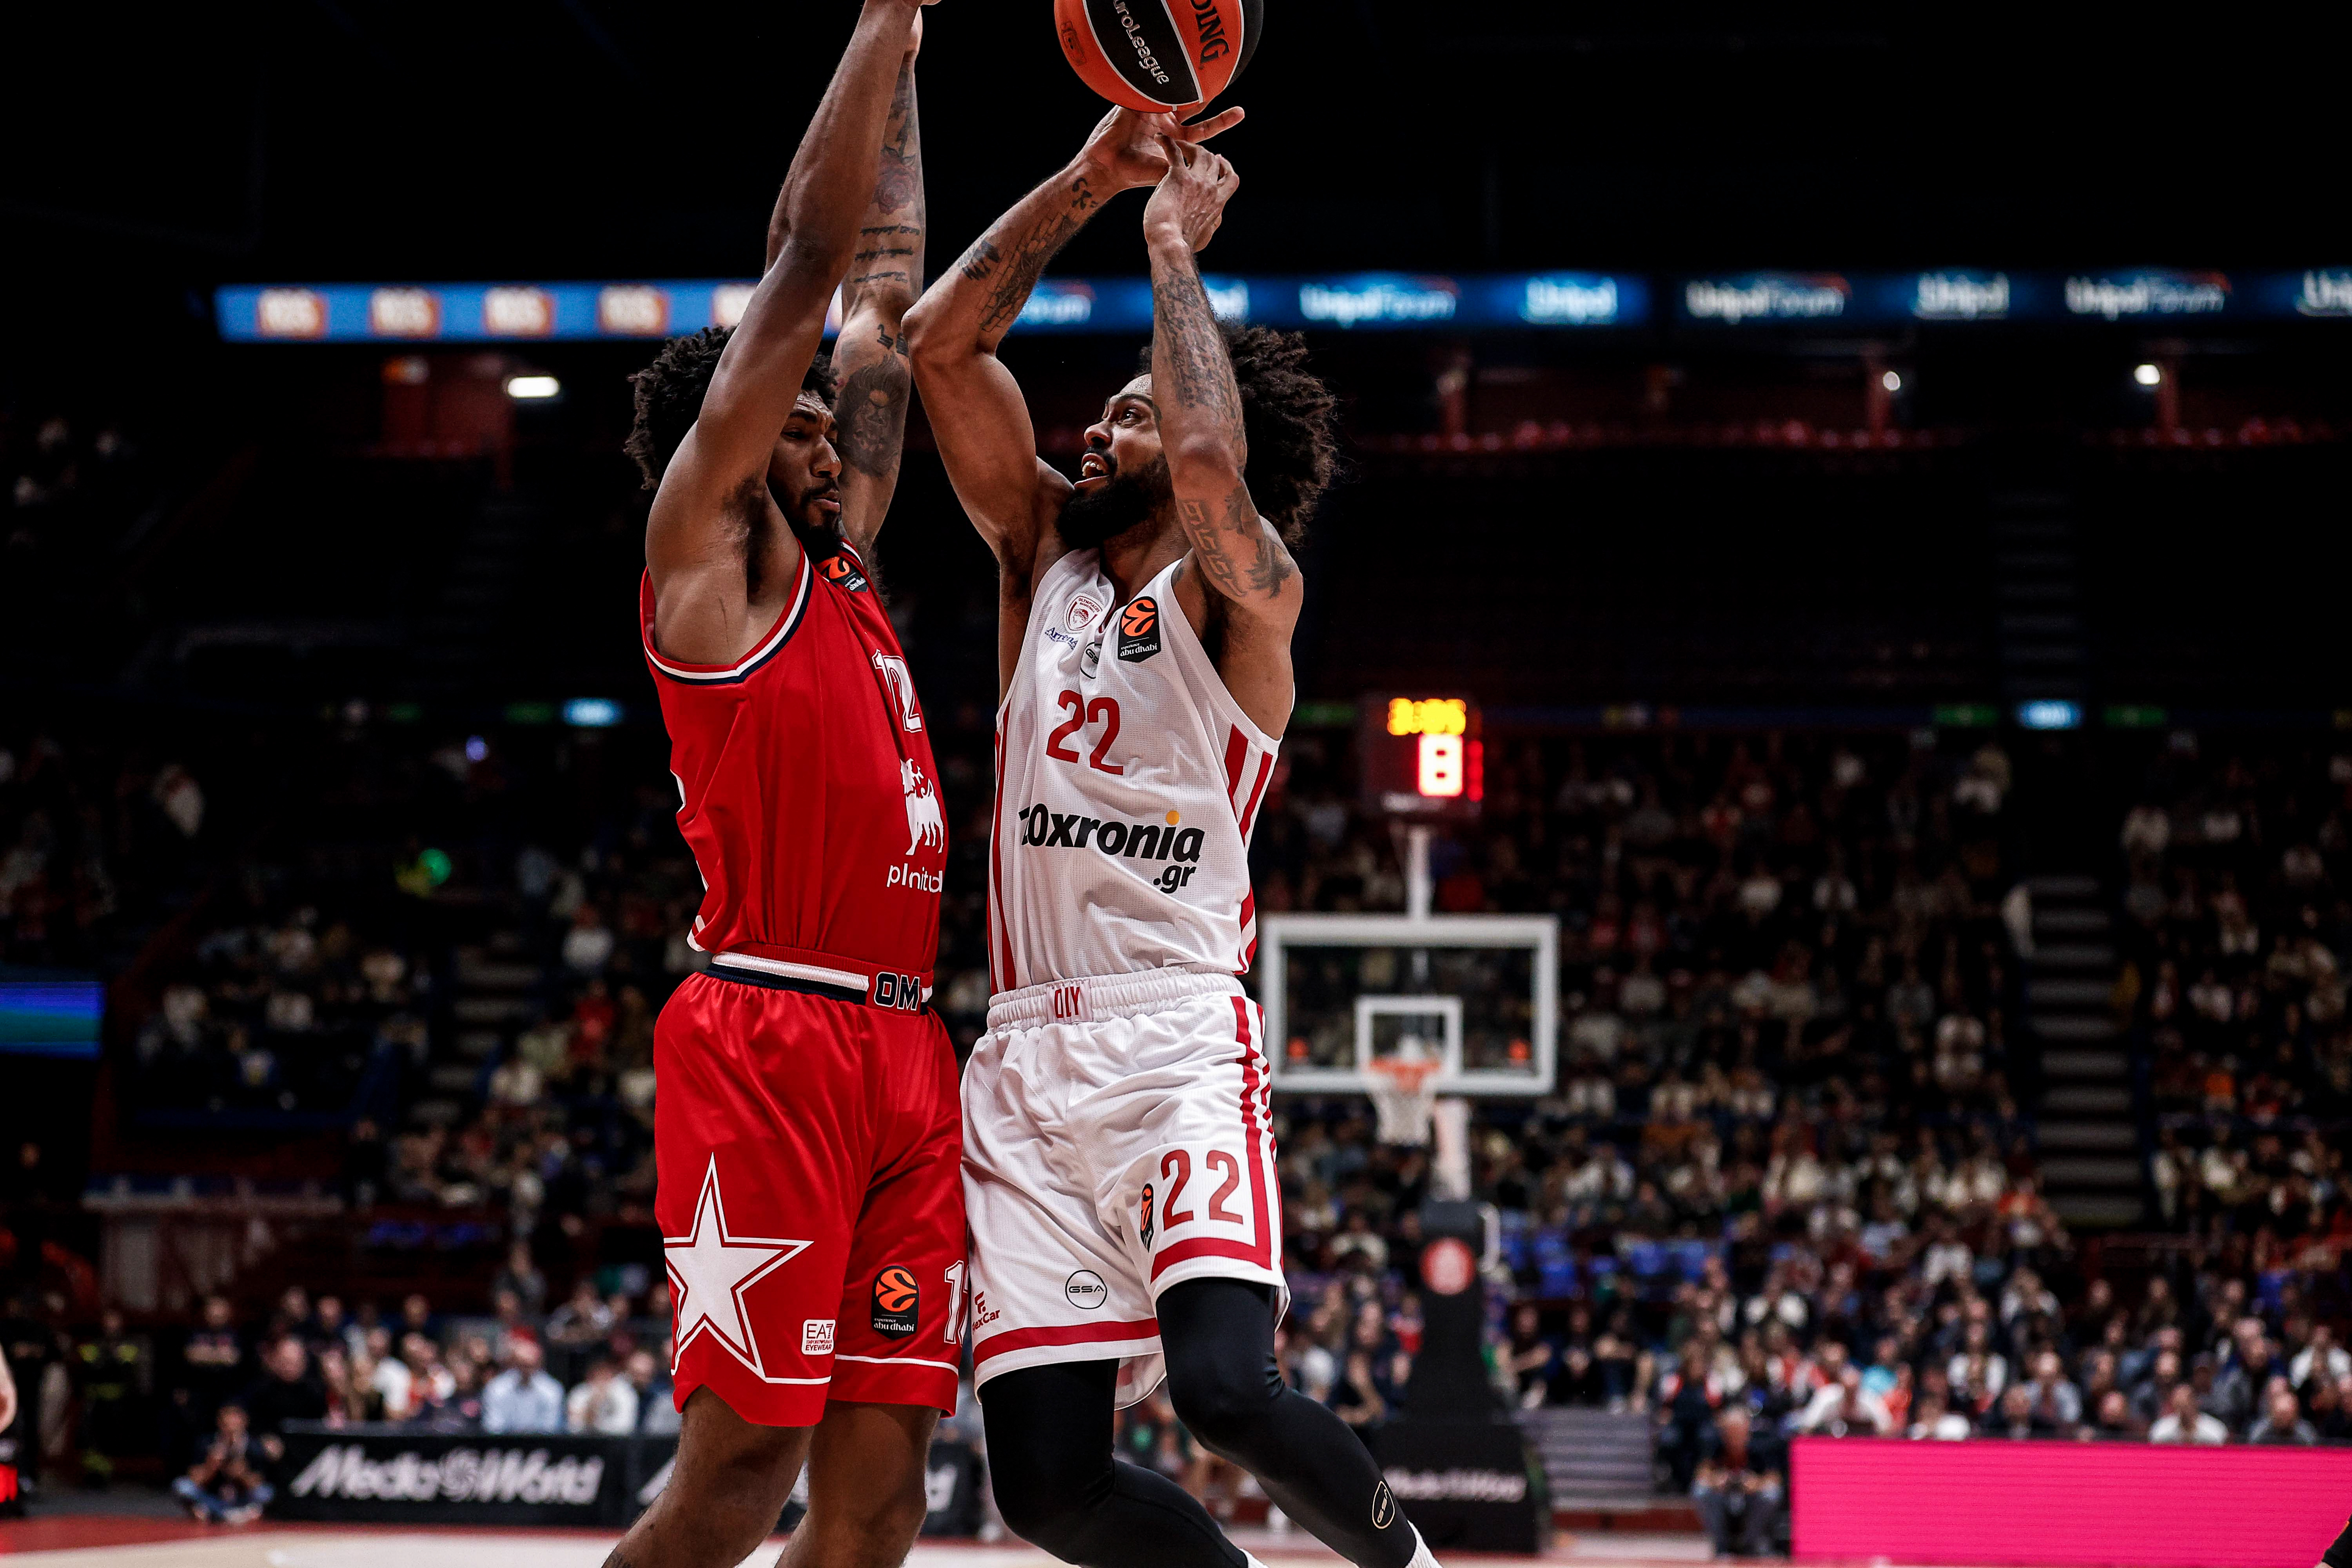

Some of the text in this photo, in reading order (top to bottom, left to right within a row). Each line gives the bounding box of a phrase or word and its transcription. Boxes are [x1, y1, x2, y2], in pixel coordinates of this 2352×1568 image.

[1113, 0, 1169, 84] uroLeague
[1078, 598, 1100, 613] OLYMPIACOS
[1085, 648, 1099, 664] GS
[1135, 643, 1157, 653] dhabi
[872, 649, 923, 733] 12
[1046, 690, 1123, 776] 22
[887, 863, 943, 893] plnitud
[1153, 865, 1197, 894] .gr
[874, 971, 920, 1012] OM
[1054, 986, 1080, 1018] OLY
[1161, 1149, 1243, 1231] 22
[1069, 1285, 1104, 1293] GSA
[806, 1323, 834, 1339] EA7
[873, 1322, 915, 1332] abu dhabi
